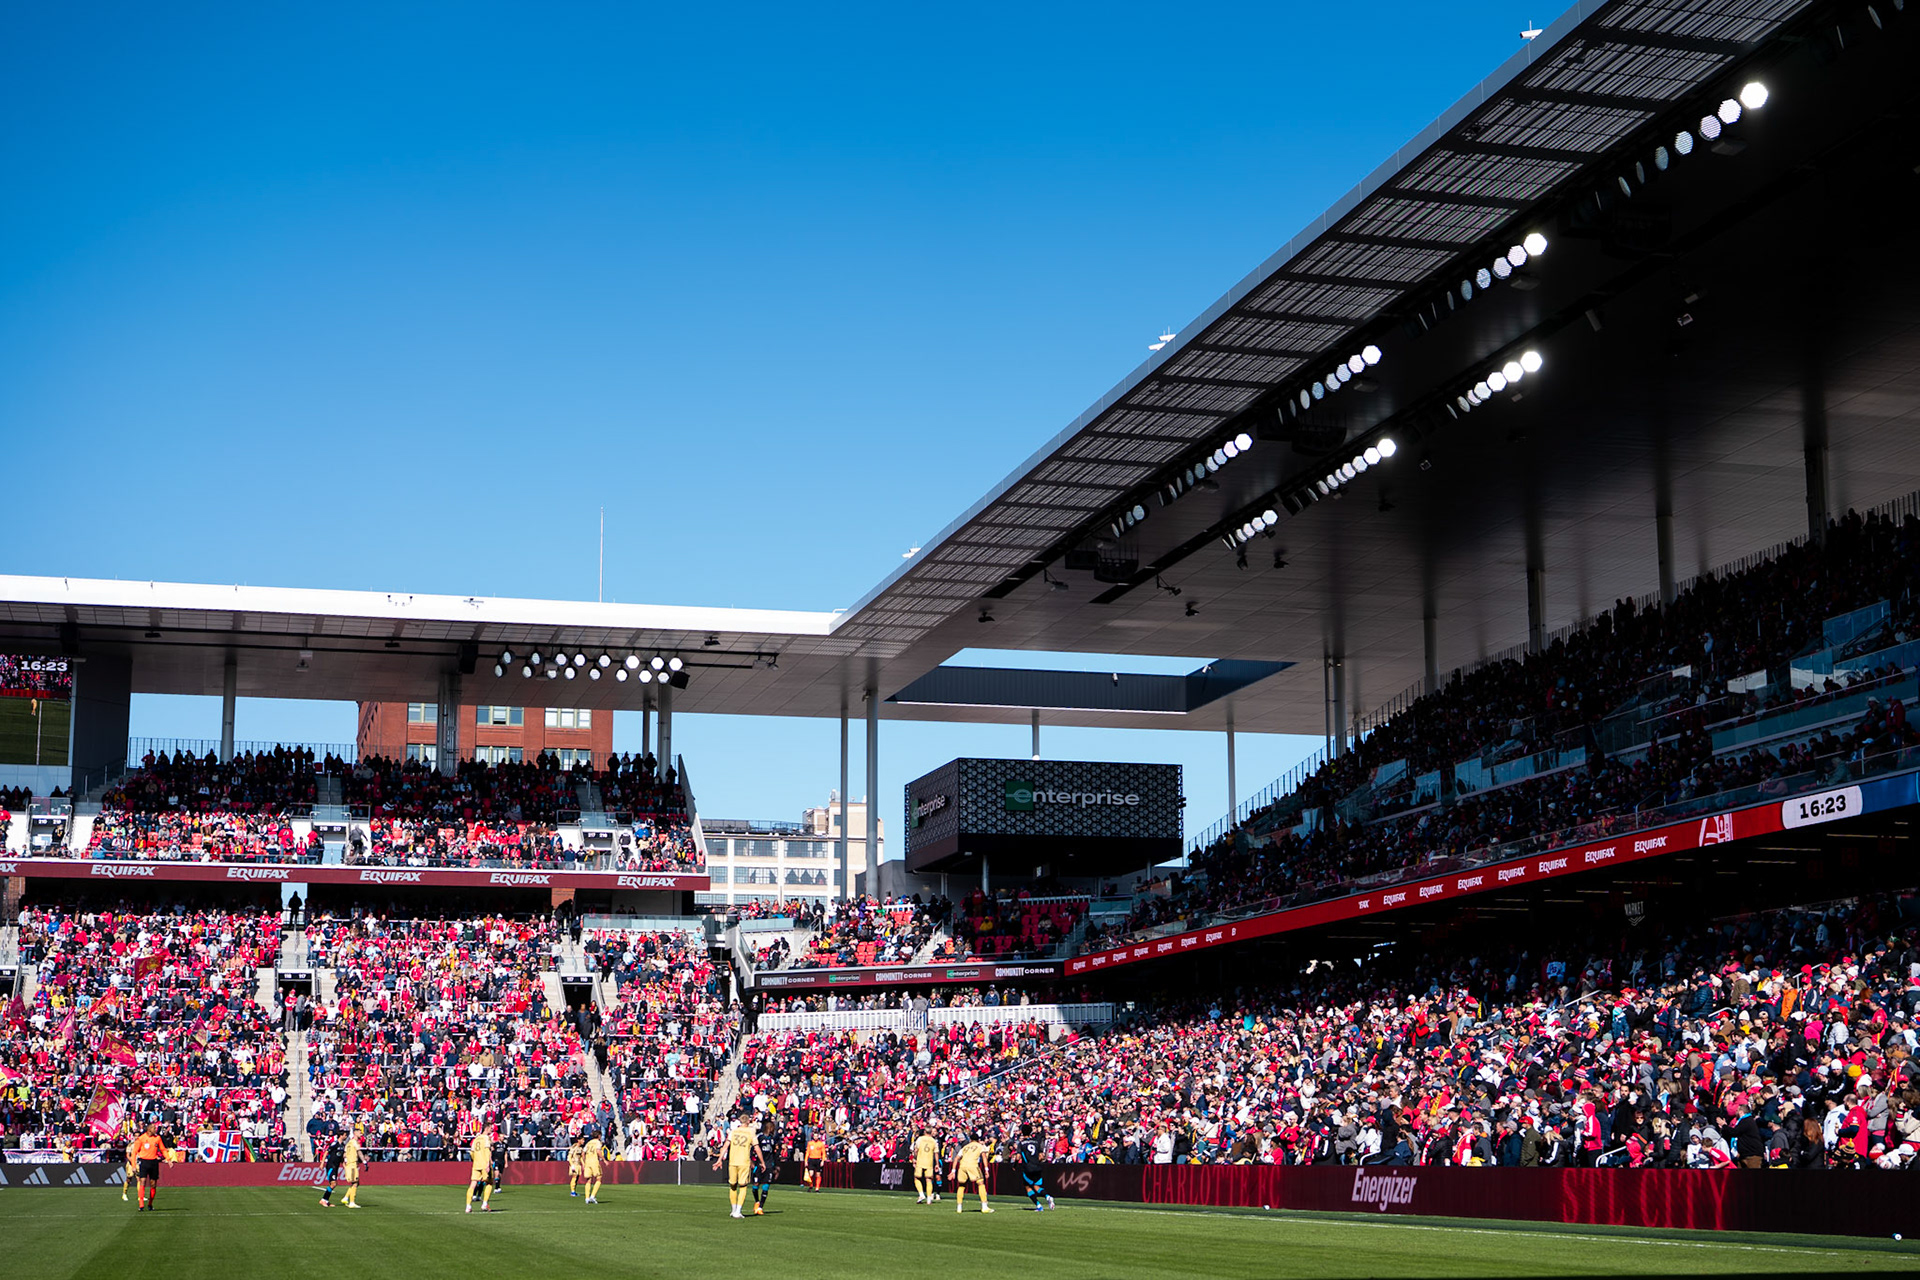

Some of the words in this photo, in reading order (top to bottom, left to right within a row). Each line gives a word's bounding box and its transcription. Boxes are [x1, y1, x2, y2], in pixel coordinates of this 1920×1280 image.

[21, 660, 68, 672] 16:23
[1006, 789, 1140, 808] enterprise
[912, 794, 946, 820] enterprise
[1800, 794, 1846, 819] 16:23
[1634, 836, 1668, 853] EQUIFAX
[1585, 847, 1616, 864] EQUIFAX
[91, 864, 156, 878] EQUIFAX
[1539, 858, 1568, 874] EQUIFAX
[227, 868, 290, 881] EQUIFAX
[360, 870, 422, 884] EQUIFAX
[490, 873, 550, 886] EQUIFAX
[1498, 866, 1526, 882] EQUIFAX
[617, 876, 676, 889] EQUIFAX
[1458, 876, 1483, 890] EQUIFAX
[1420, 884, 1444, 898] EQUIFAX
[1383, 892, 1406, 906] EQUIFAX
[1181, 937, 1197, 947] EQUIFAX
[1206, 932, 1223, 943] EQUIFAX
[876, 972, 903, 981] COMMUNITY
[995, 967, 1024, 977] COMMUNITY
[761, 977, 787, 986] COMMUNITY
[475, 1142, 481, 1151] 8
[733, 1134, 747, 1147] 32
[924, 1143, 930, 1153] 6
[1028, 1144, 1036, 1156] 9
[1142, 1164, 1250, 1206] CHARLOTTE
[1258, 1164, 1280, 1208] FC
[1352, 1168, 1417, 1211] Energizer
[1562, 1168, 1625, 1226] STL
[1640, 1168, 1730, 1230] CITY
